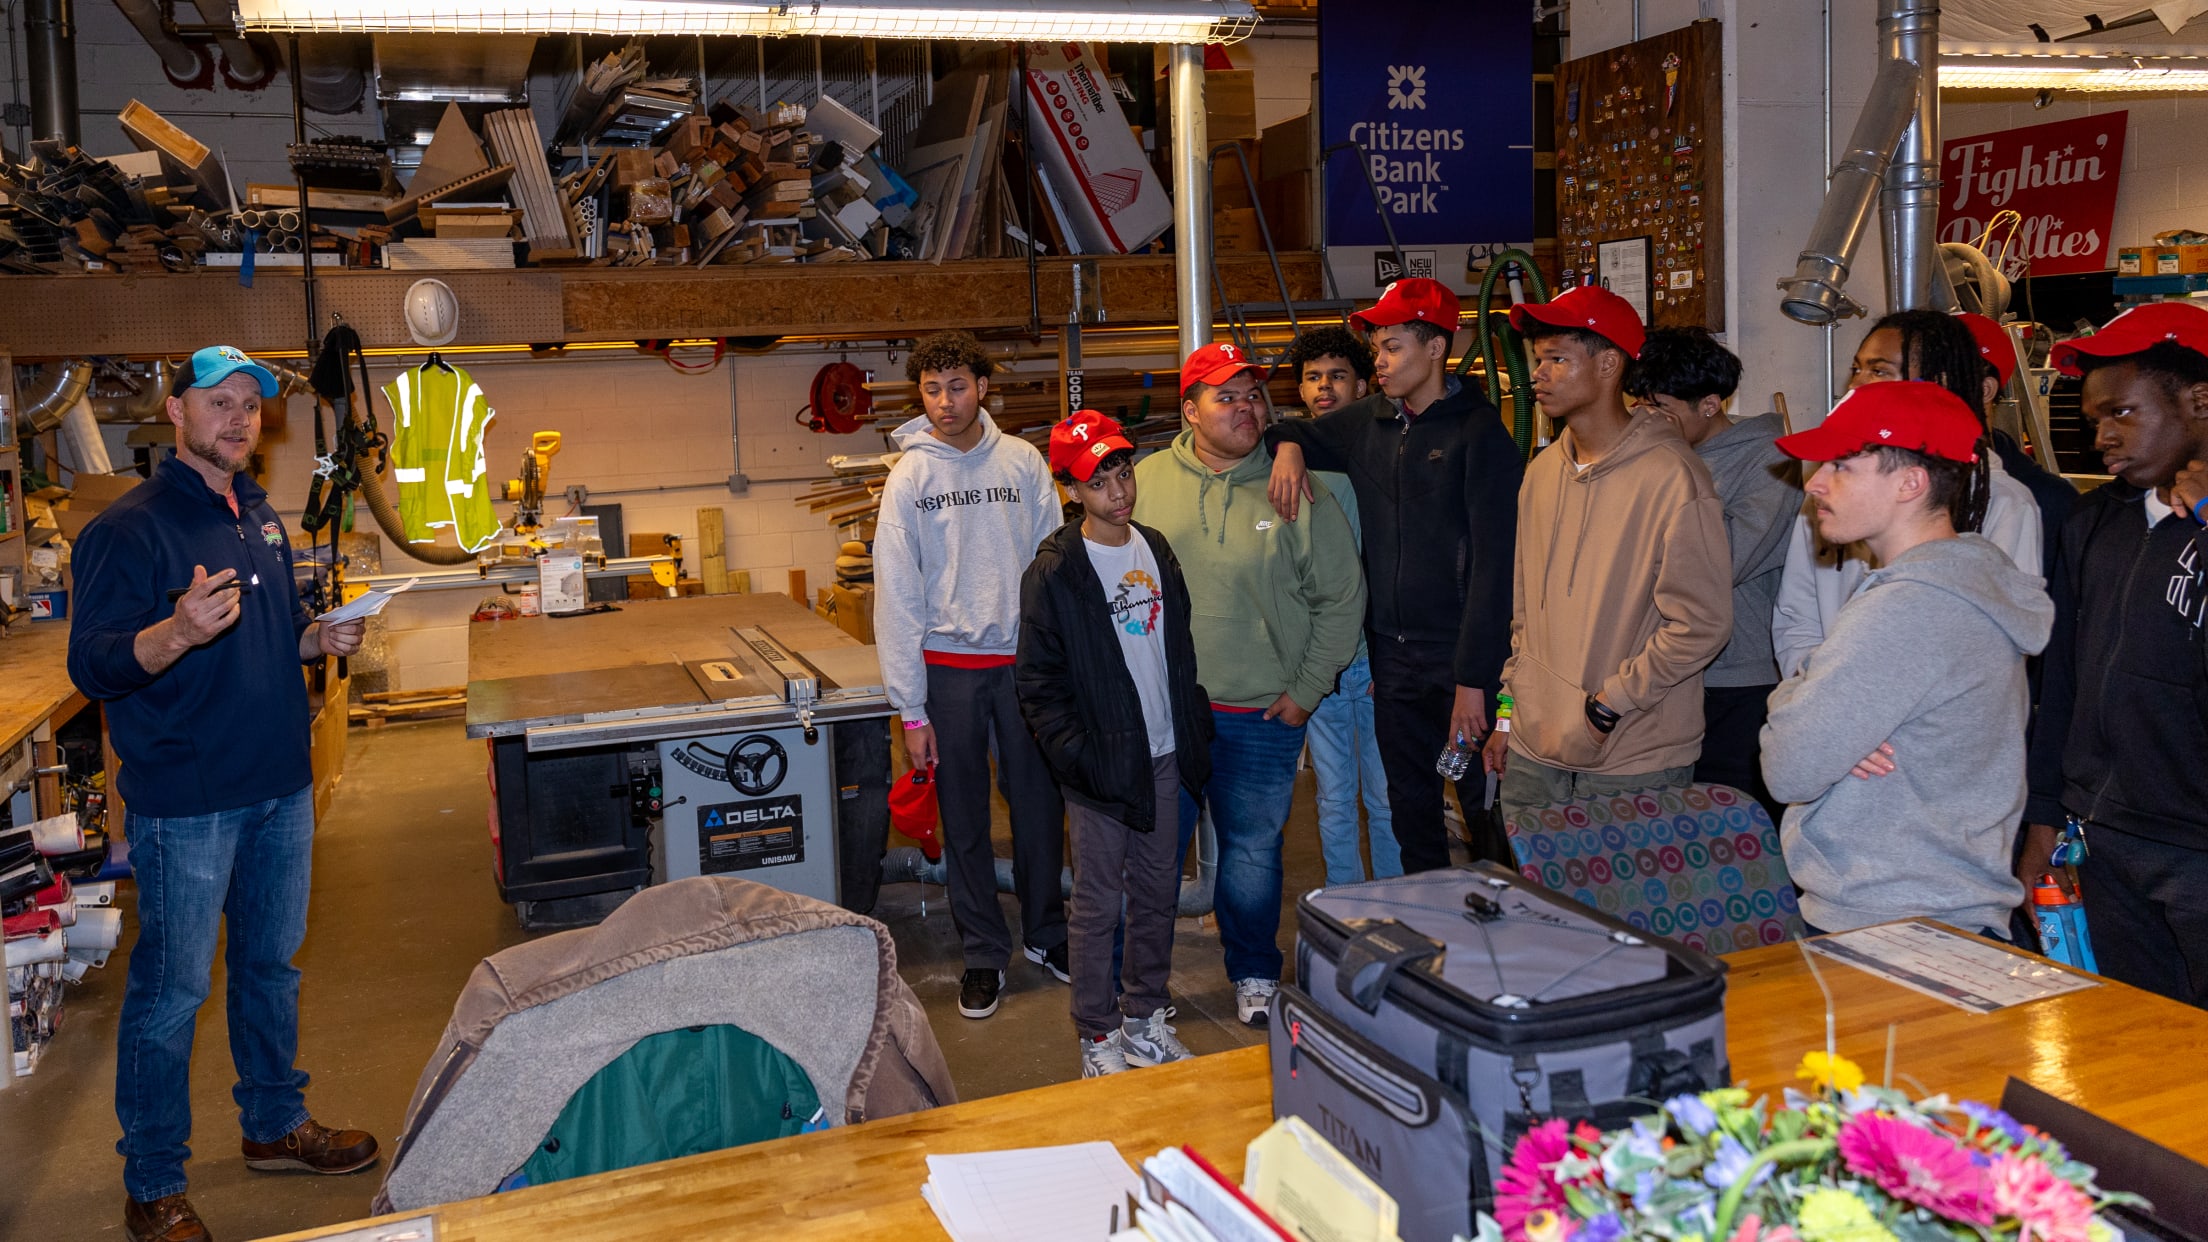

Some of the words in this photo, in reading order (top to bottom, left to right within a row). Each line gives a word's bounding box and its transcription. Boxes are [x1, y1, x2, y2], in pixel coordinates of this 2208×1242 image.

[1067, 69, 1090, 105] SAFING
[1074, 61, 1105, 114] Thermafiber
[1349, 121, 1465, 151] Citizens
[1370, 152, 1441, 183] Bank
[1949, 133, 2108, 211] Fightin'
[1376, 184, 1438, 214] Park
[1409, 258, 1432, 268] NEW
[1409, 269, 1432, 278] ERA
[1069, 376, 1083, 415] CORY
[1112, 594, 1163, 615] Champio
[726, 805, 796, 825] DELTA
[761, 854, 797, 865] UNISAW
[1318, 1102, 1382, 1172] TITAN
